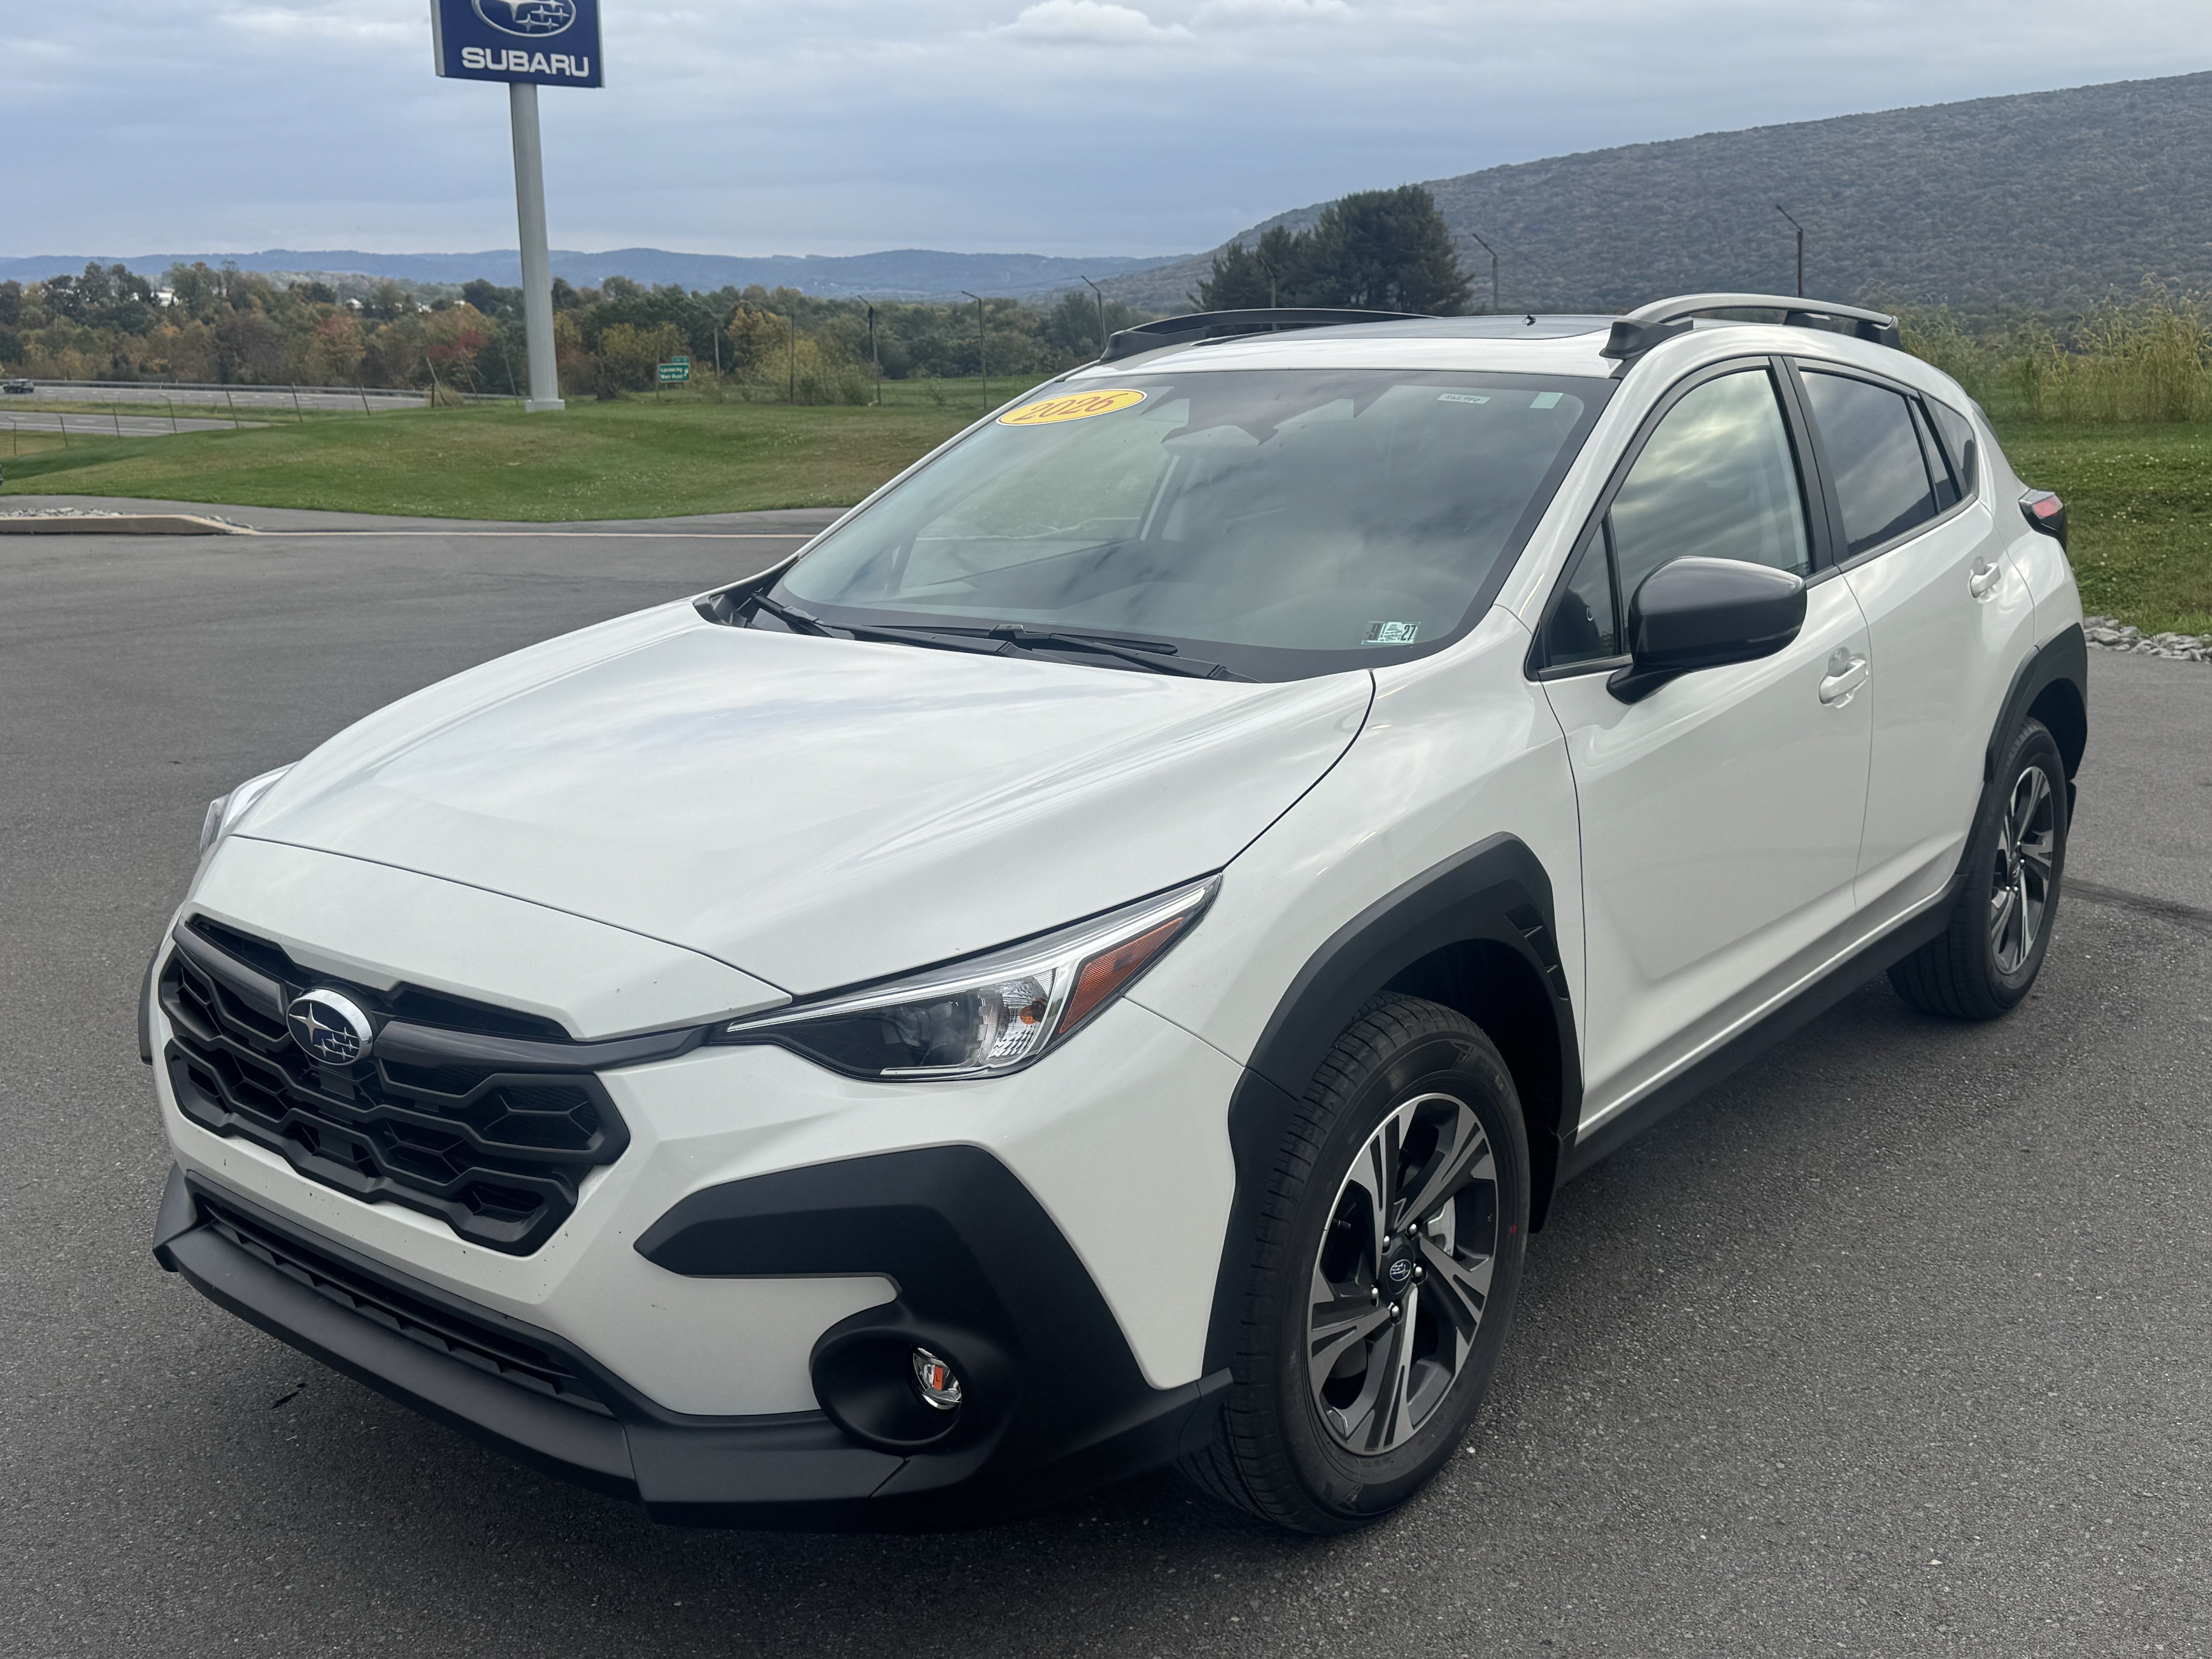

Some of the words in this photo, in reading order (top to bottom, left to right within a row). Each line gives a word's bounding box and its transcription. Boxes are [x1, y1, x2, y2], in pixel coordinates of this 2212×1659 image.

[461, 47, 589, 78] SUBARU
[1012, 393, 1129, 422] 2026
[1400, 625, 1417, 641] 27
